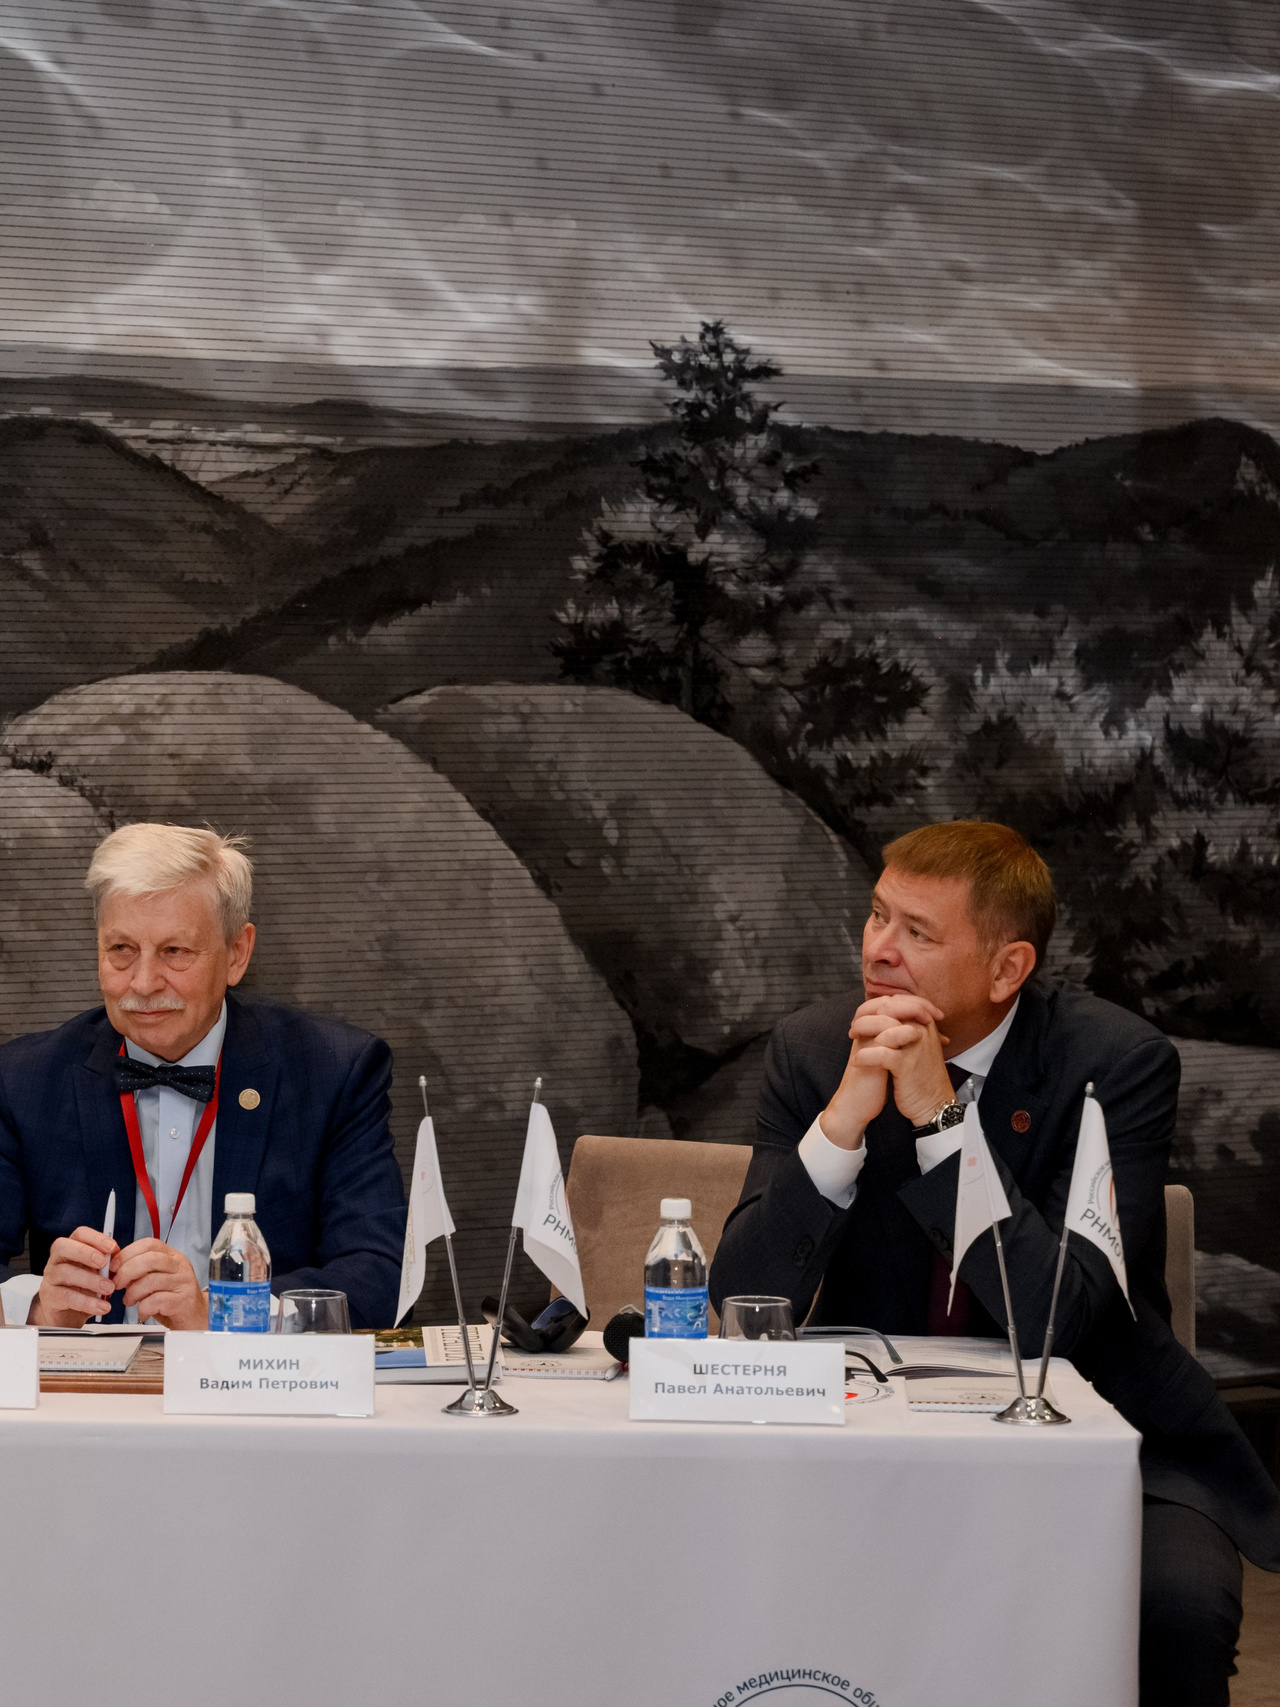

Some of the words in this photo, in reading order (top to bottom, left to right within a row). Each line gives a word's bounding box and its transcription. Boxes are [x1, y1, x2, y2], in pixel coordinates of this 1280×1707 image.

[1080, 1208, 1124, 1264] РНМО
[238, 1359, 300, 1371] МИХИН
[693, 1363, 787, 1377] ШЕСТЕРНЯ
[200, 1378, 252, 1391] Вадим
[259, 1378, 339, 1392] Петрович
[654, 1382, 707, 1395] Павел
[713, 1383, 826, 1397] Анатольевич
[713, 1691, 735, 1707] ое
[736, 1668, 850, 1695] медицинское
